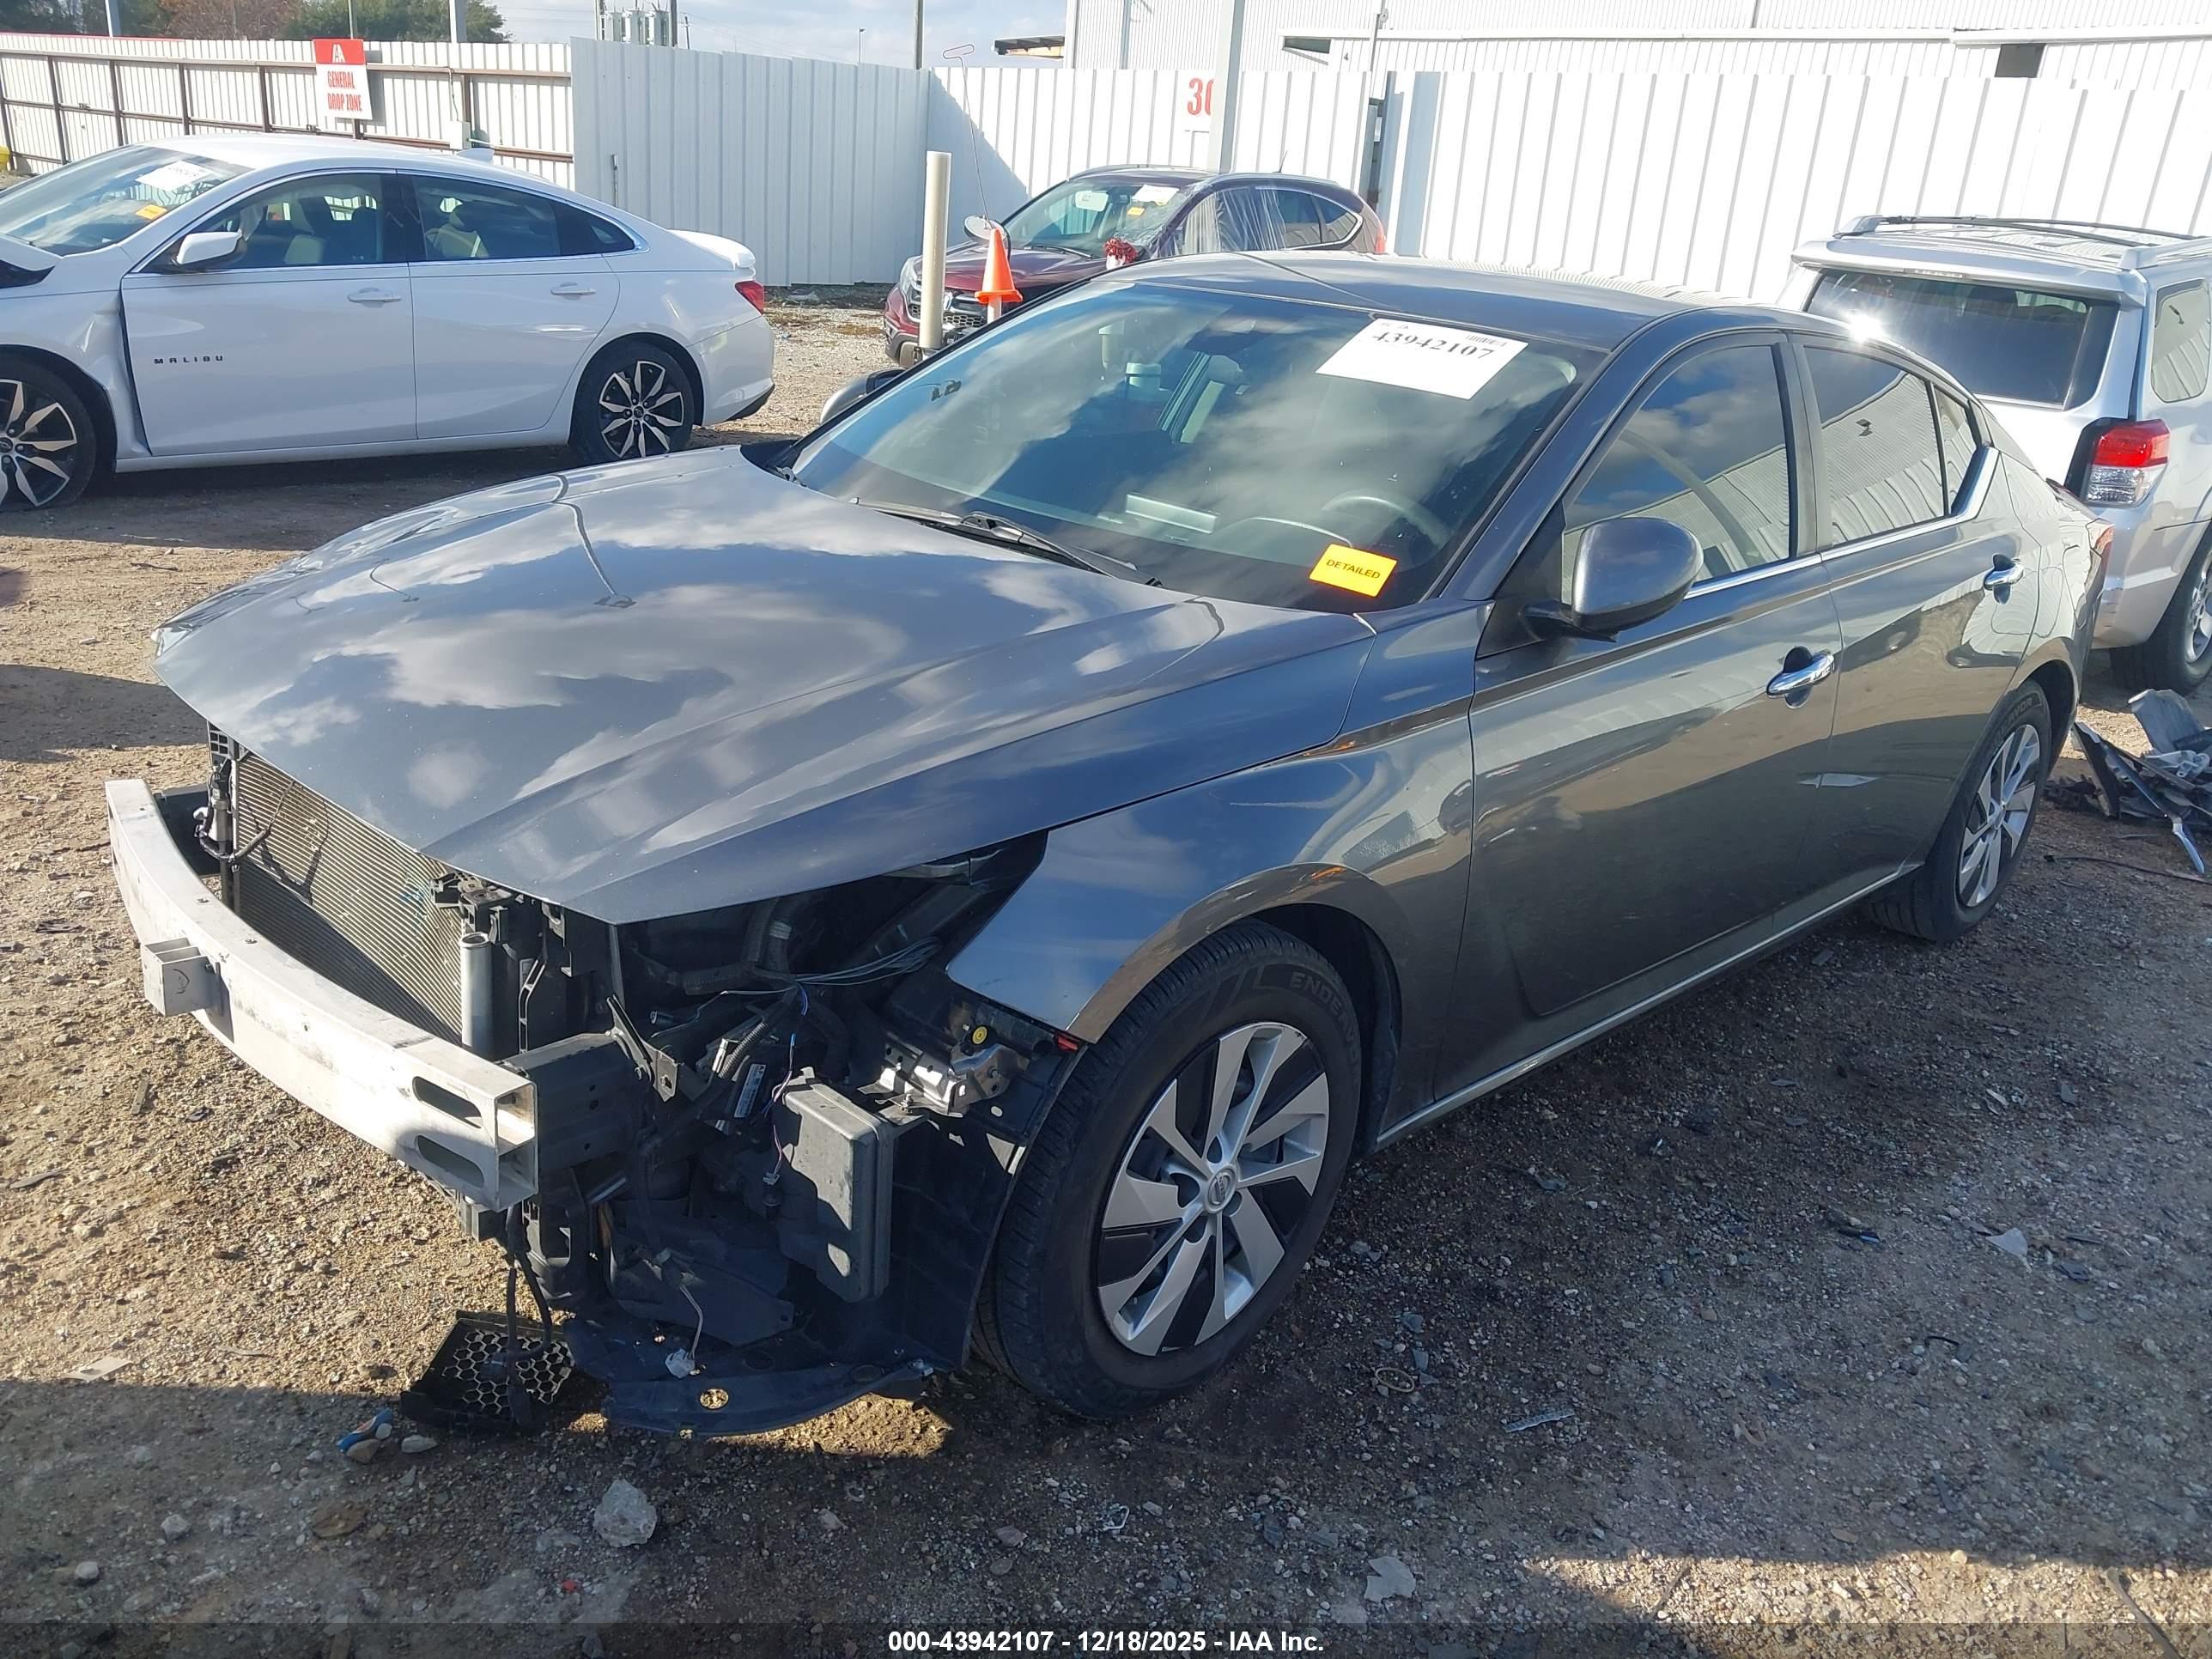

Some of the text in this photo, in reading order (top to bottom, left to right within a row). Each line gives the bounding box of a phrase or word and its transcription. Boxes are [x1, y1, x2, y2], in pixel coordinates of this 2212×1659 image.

[327, 71, 355, 89] GENERAL
[327, 93, 362, 112] DROP ZONE
[1372, 331, 1495, 359] 43942107
[154, 355, 223, 364] MALIBU
[1326, 559, 1381, 579] DETAILED
